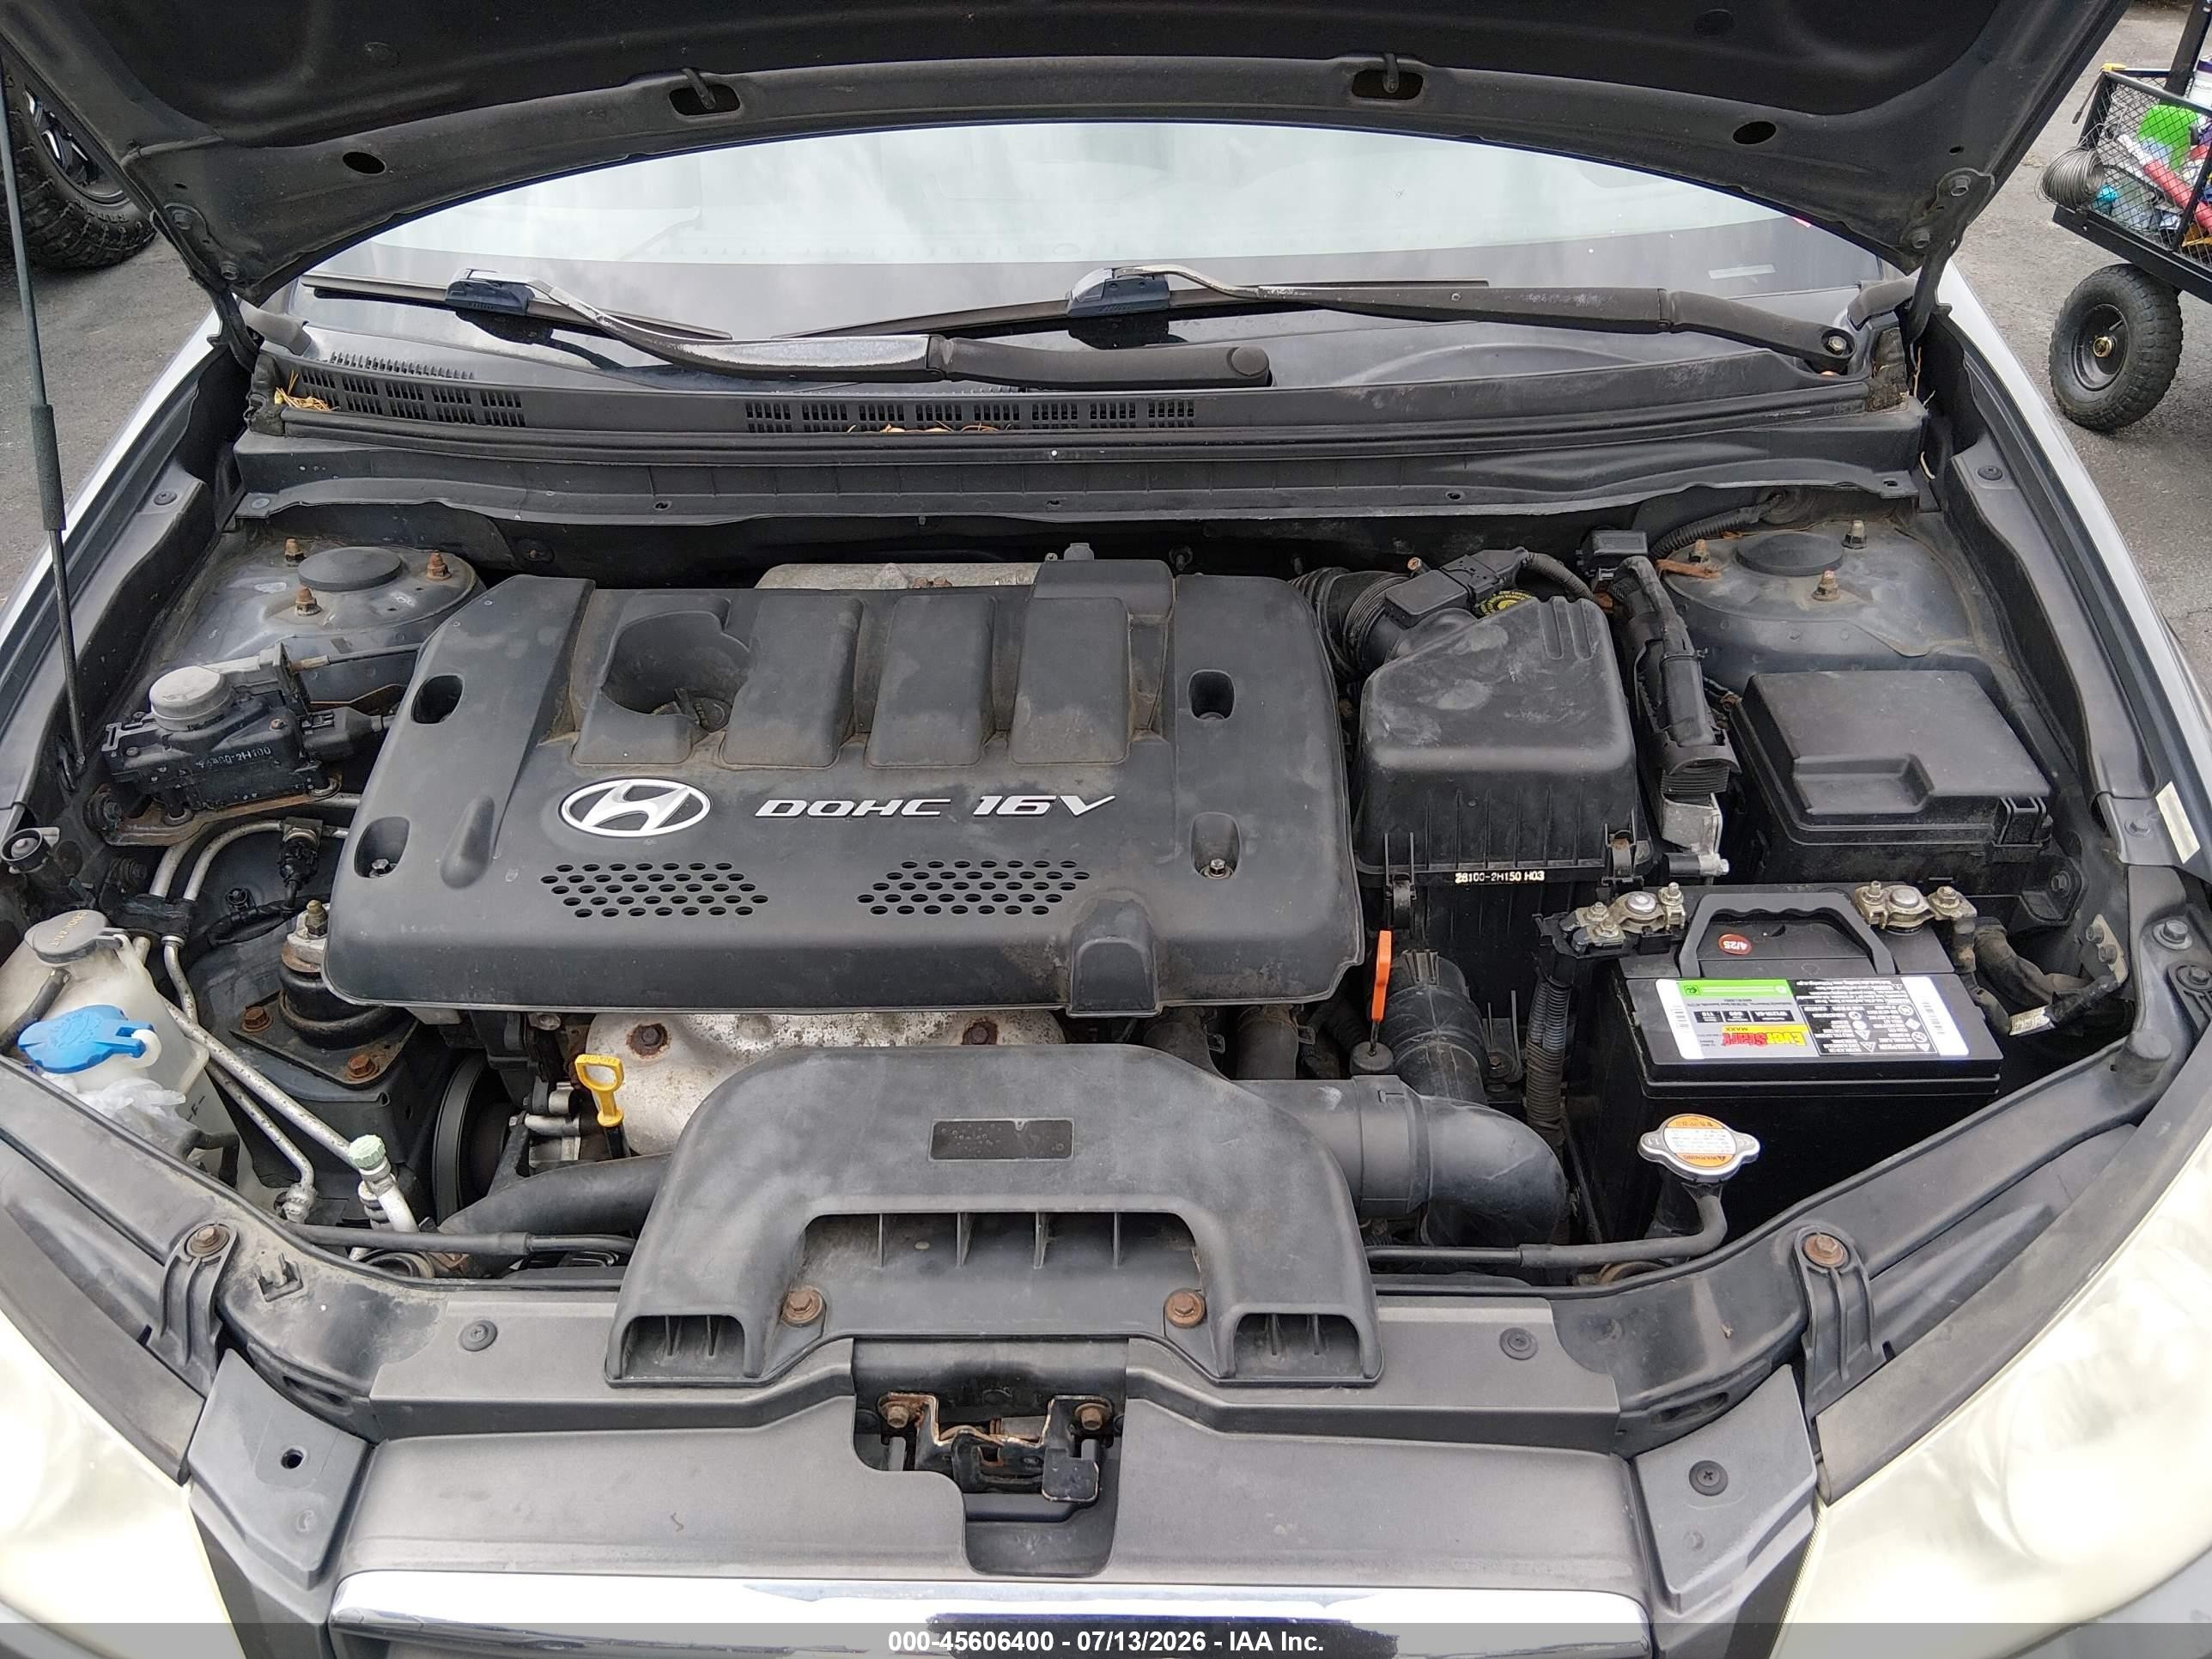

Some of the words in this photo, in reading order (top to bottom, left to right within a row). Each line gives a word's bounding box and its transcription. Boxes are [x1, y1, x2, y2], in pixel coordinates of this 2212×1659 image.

[755, 799, 951, 817] DOHC
[972, 795, 1116, 817] 16V
[49, 911, 88, 949] COOLANT
[1723, 940, 1748, 951] 4/25
[1722, 1031, 1807, 1048] EverStart
